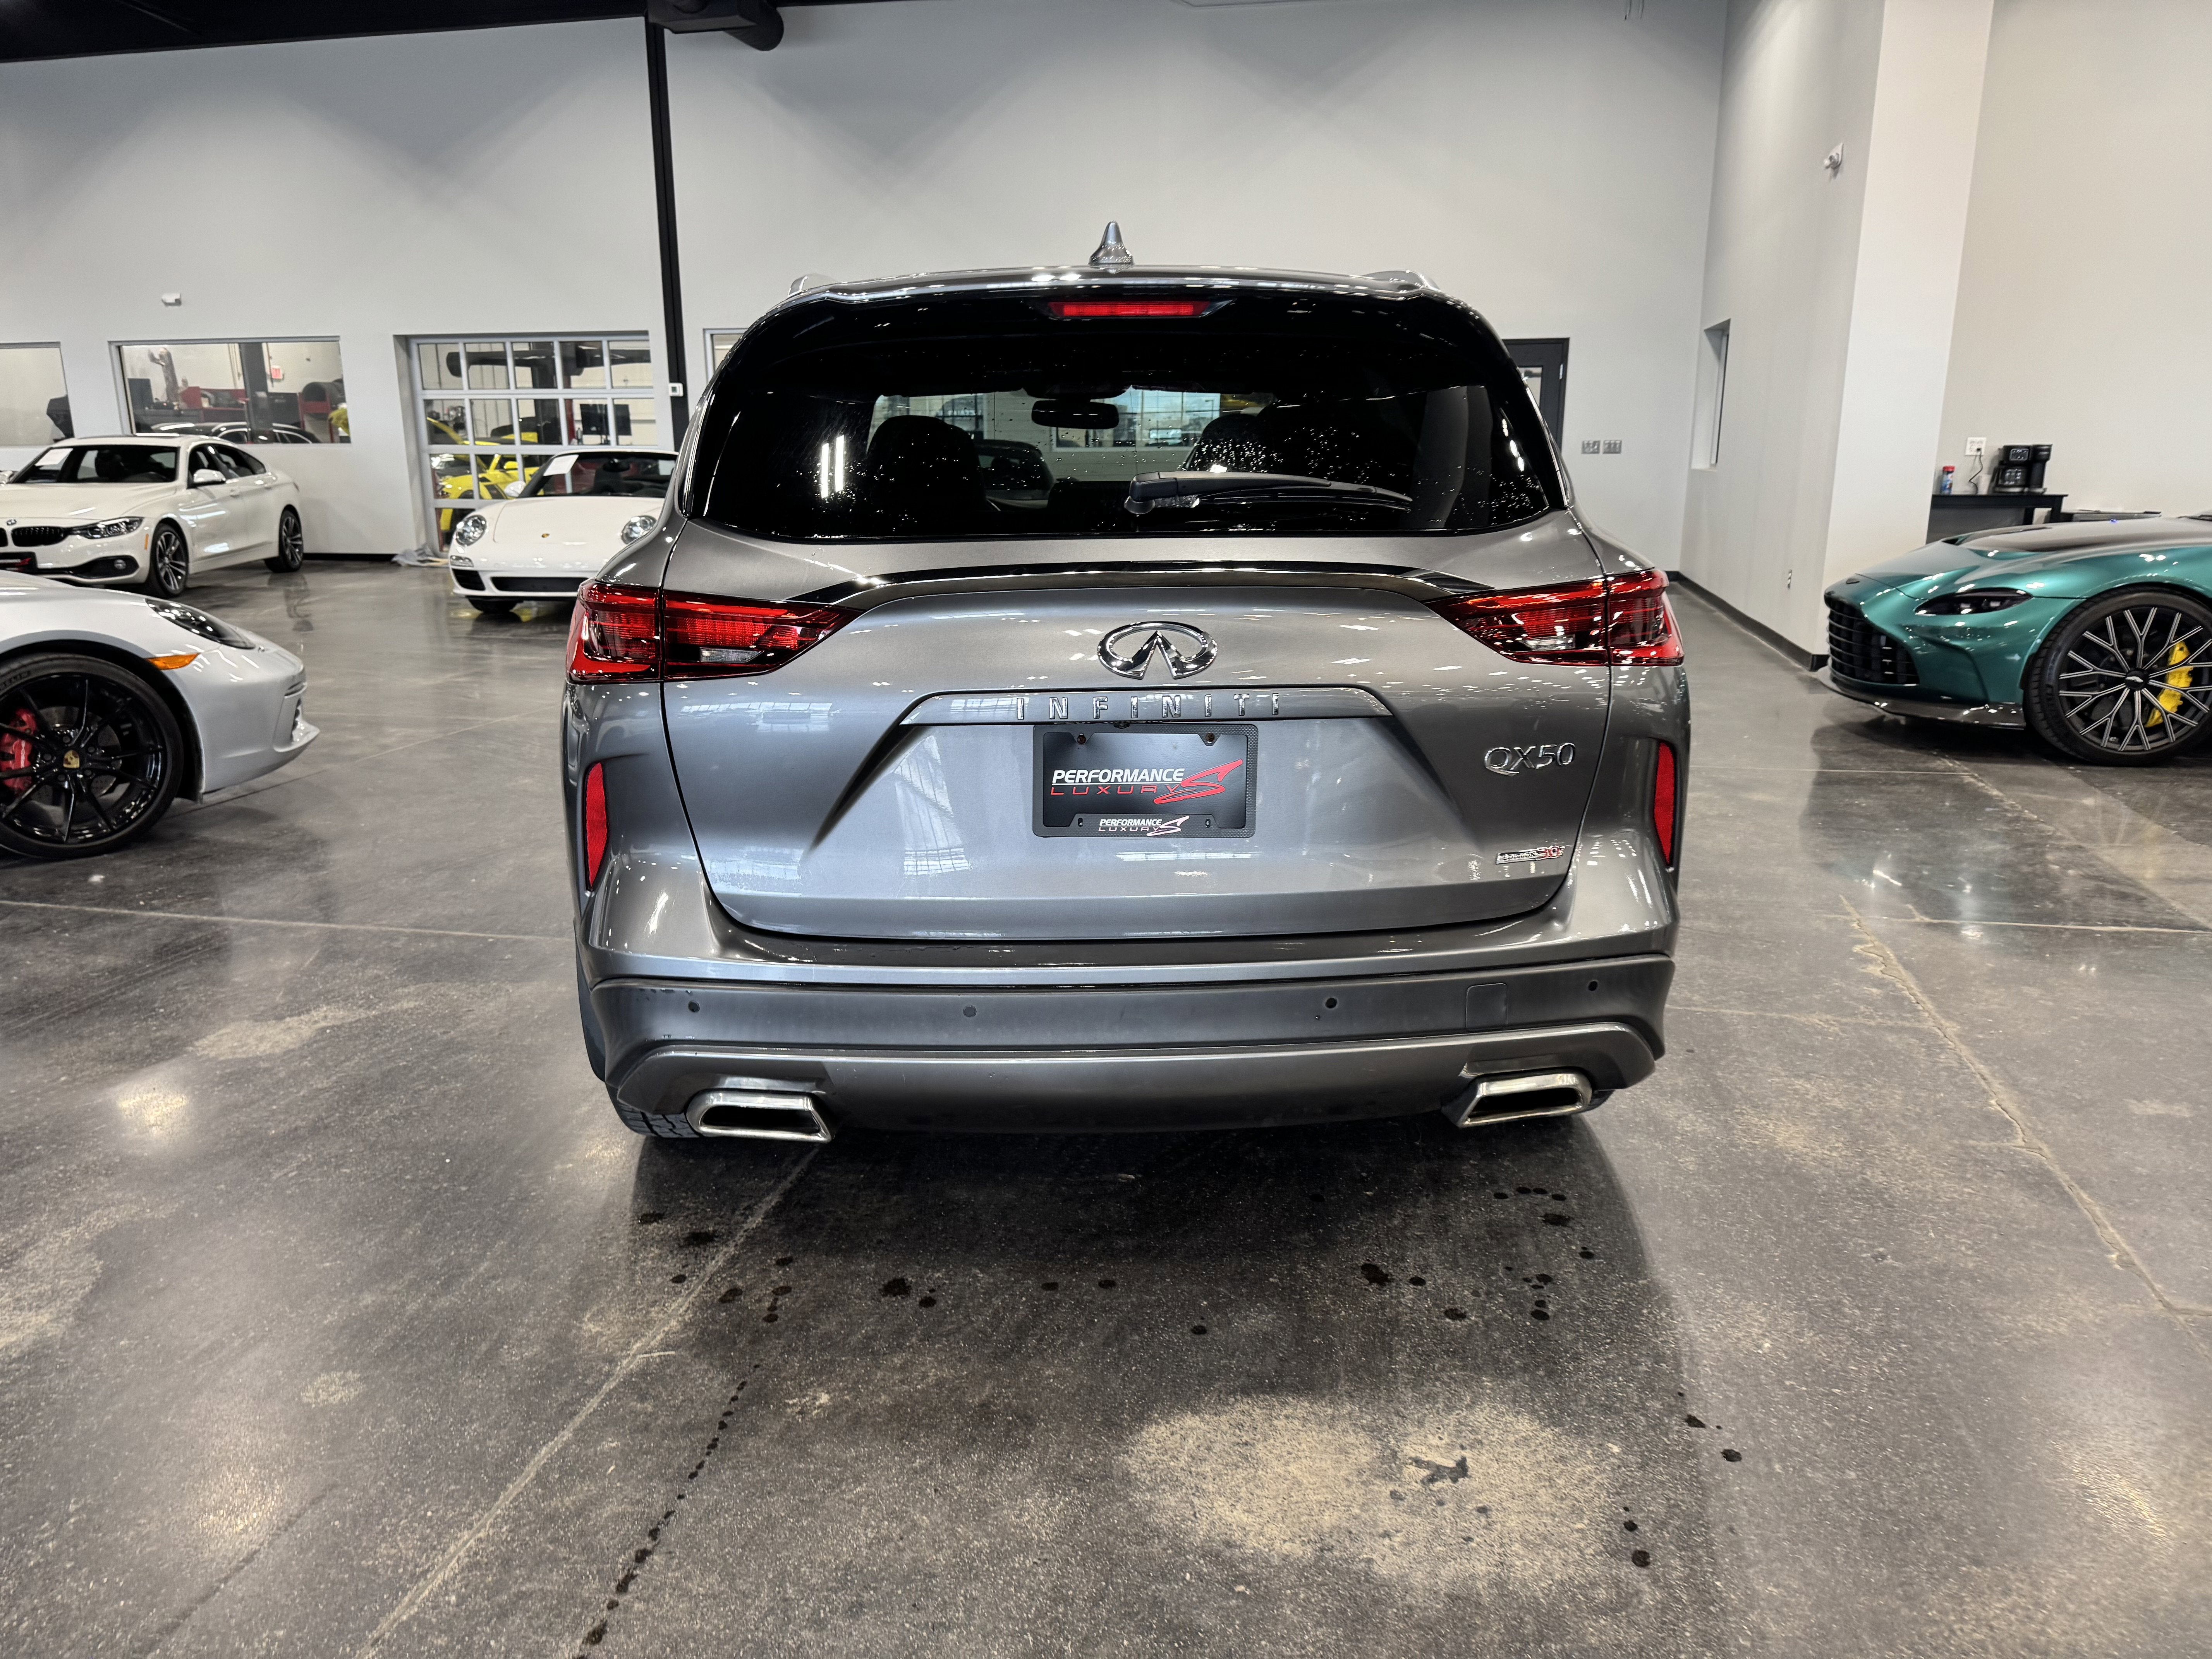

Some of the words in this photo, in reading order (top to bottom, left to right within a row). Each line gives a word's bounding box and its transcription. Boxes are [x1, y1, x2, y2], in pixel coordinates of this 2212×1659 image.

[1017, 693, 1279, 720] INFINITI
[1484, 742, 1576, 776] QX50
[1052, 768, 1185, 783] PERFORMANCE
[1050, 785, 1180, 795] LUXURY
